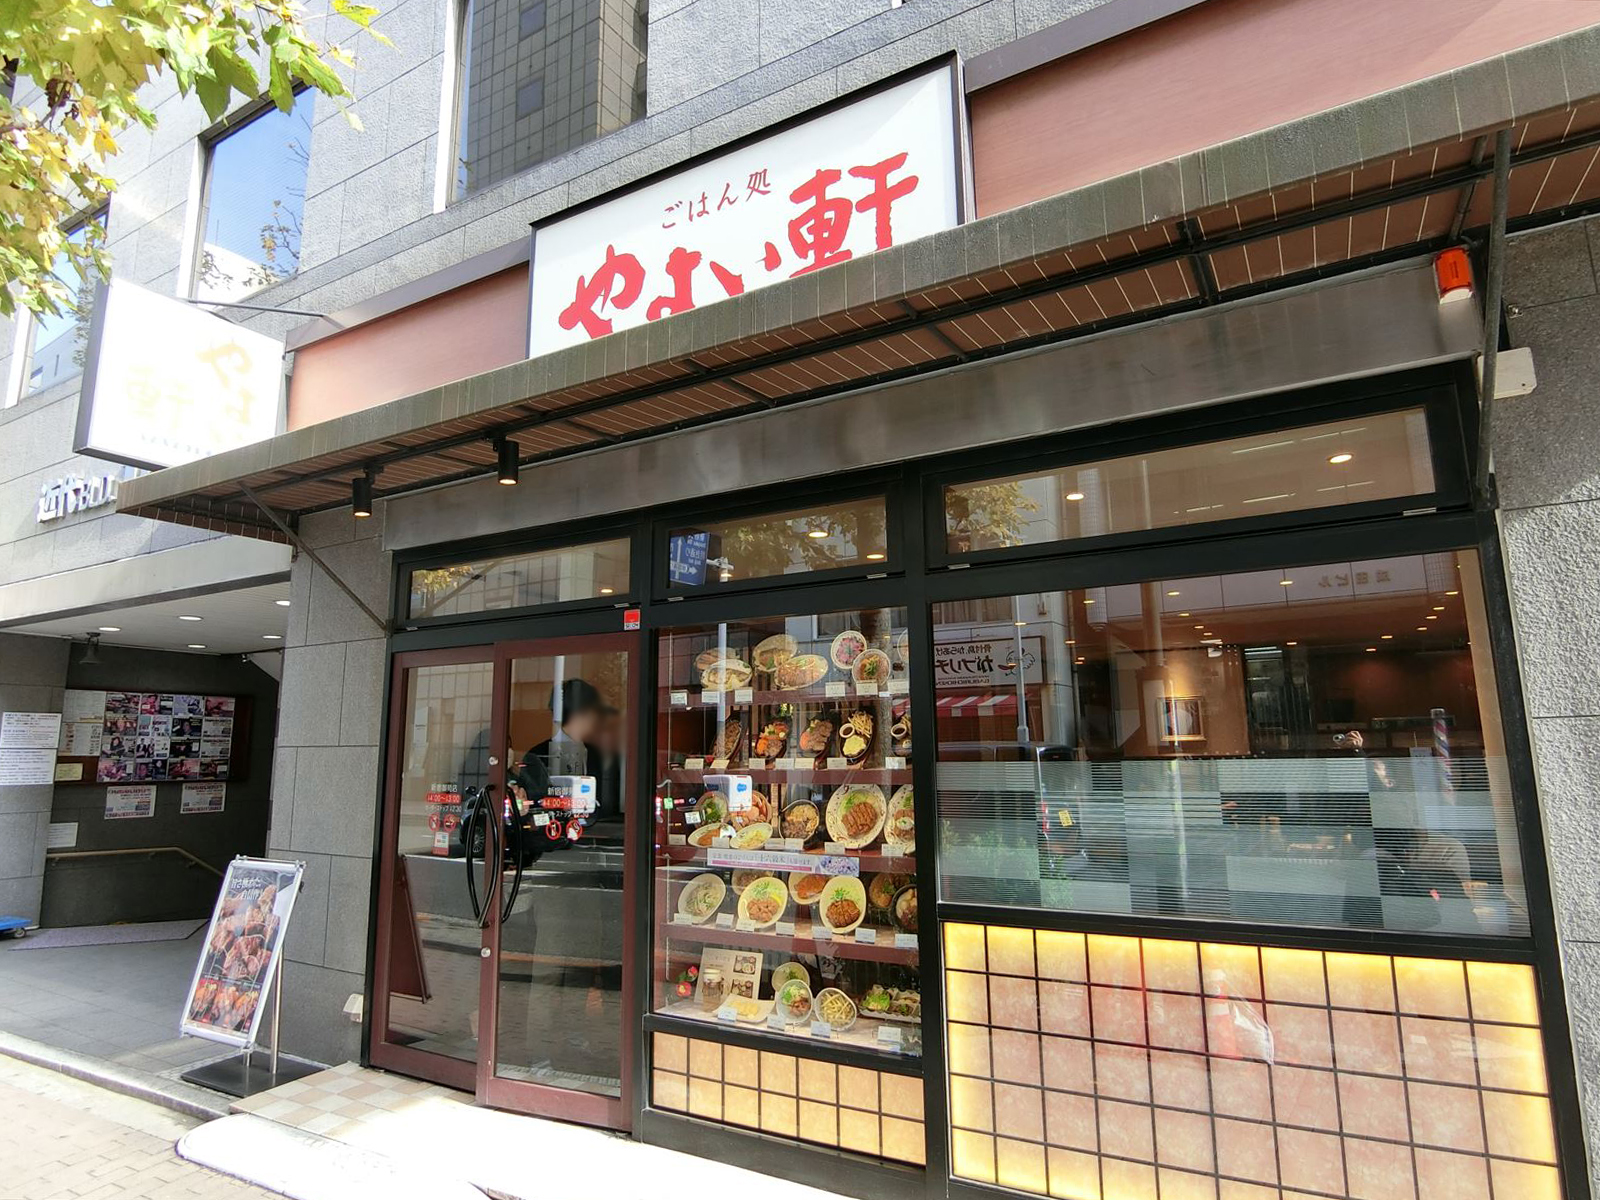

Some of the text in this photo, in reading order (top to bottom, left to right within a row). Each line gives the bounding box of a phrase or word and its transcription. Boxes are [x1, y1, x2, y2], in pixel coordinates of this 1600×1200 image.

[558, 152, 919, 339] やよい軒
[662, 168, 772, 230] ごはん処
